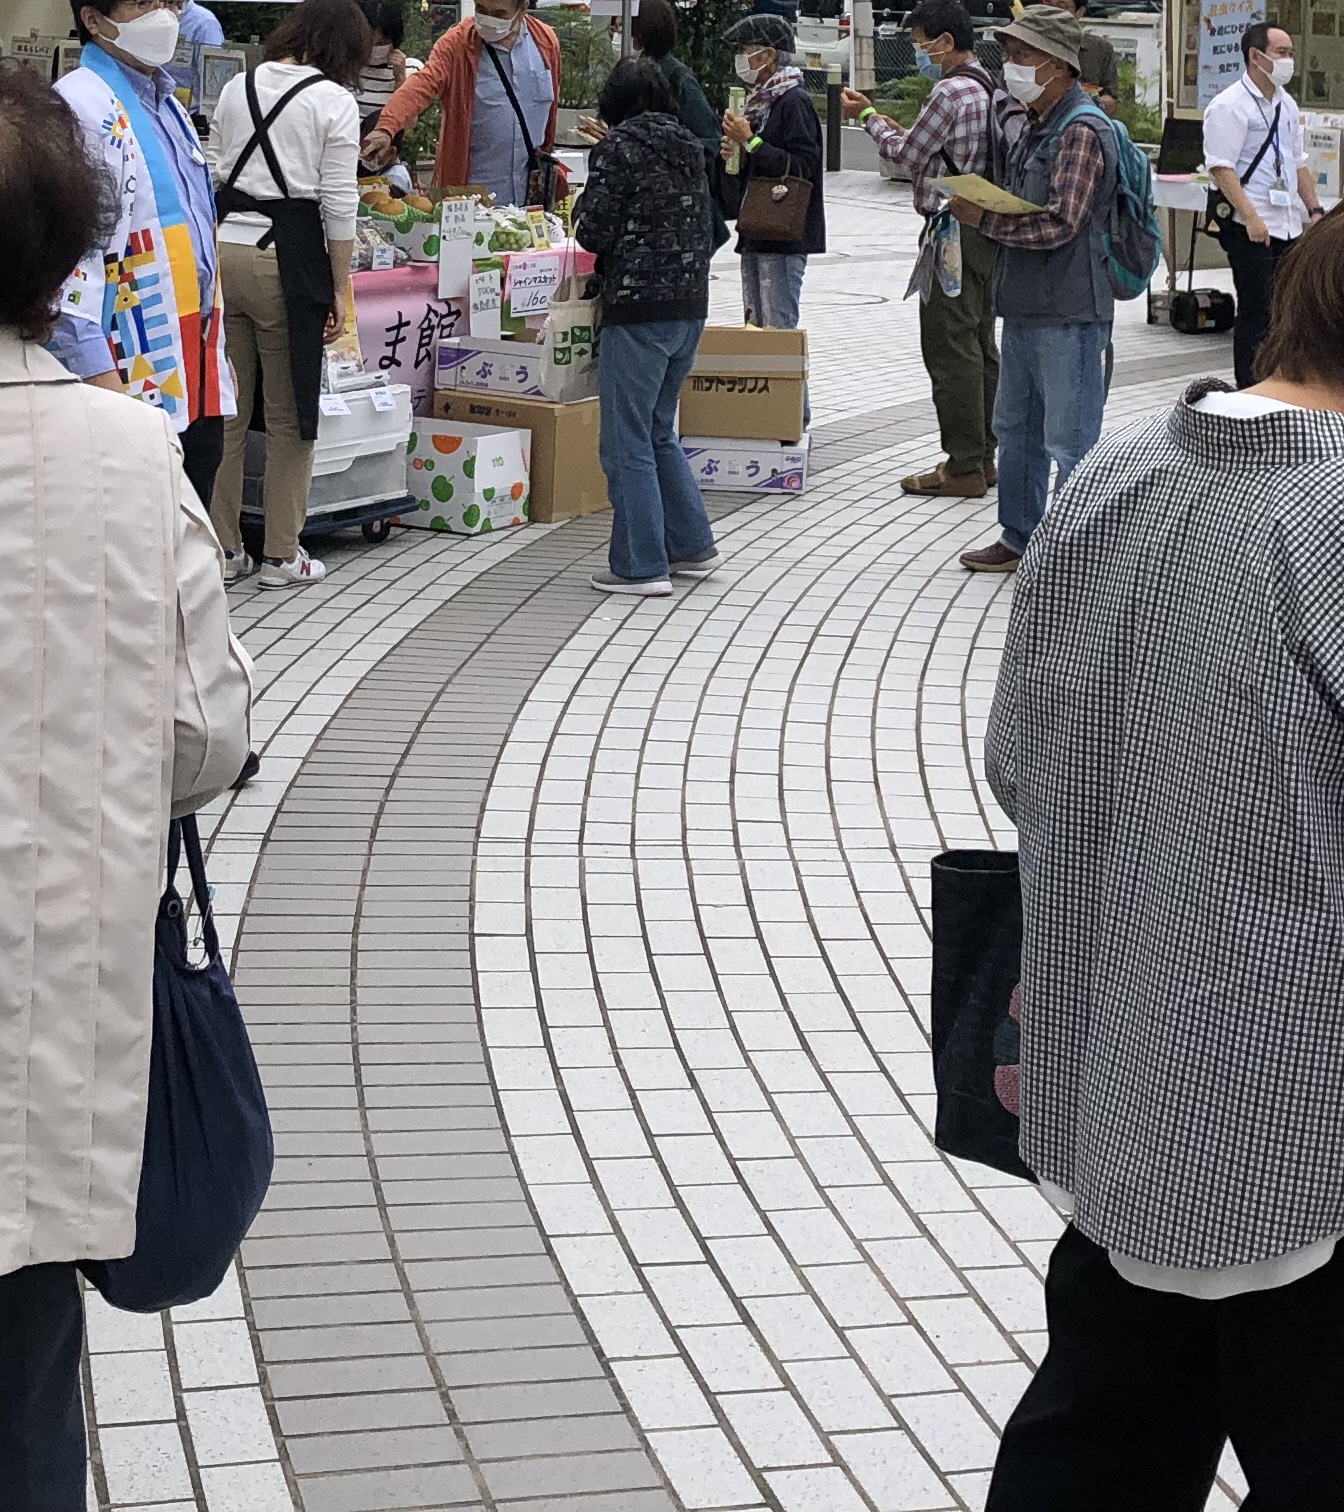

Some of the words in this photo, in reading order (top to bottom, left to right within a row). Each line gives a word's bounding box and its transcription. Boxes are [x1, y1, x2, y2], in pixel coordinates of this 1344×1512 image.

[362, 300, 462, 370] ま館
[475, 361, 530, 384] ぶう
[700, 458, 761, 478] ぶう
